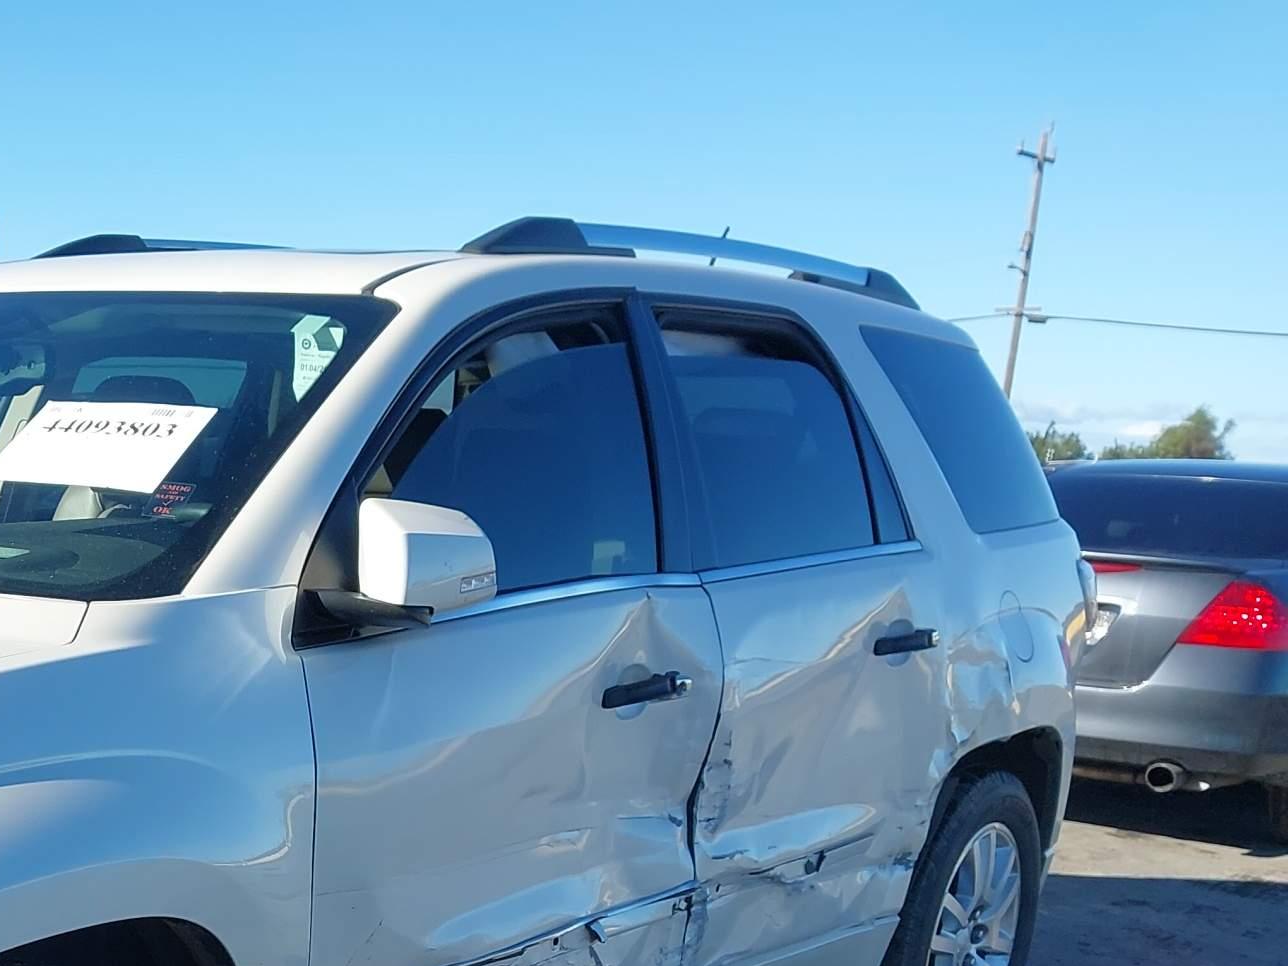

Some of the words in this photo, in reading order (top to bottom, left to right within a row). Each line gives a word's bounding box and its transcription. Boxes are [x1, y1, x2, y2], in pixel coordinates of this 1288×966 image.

[42, 418, 179, 438] 44093803
[161, 484, 192, 493] SMOG
[152, 506, 170, 515] OK
